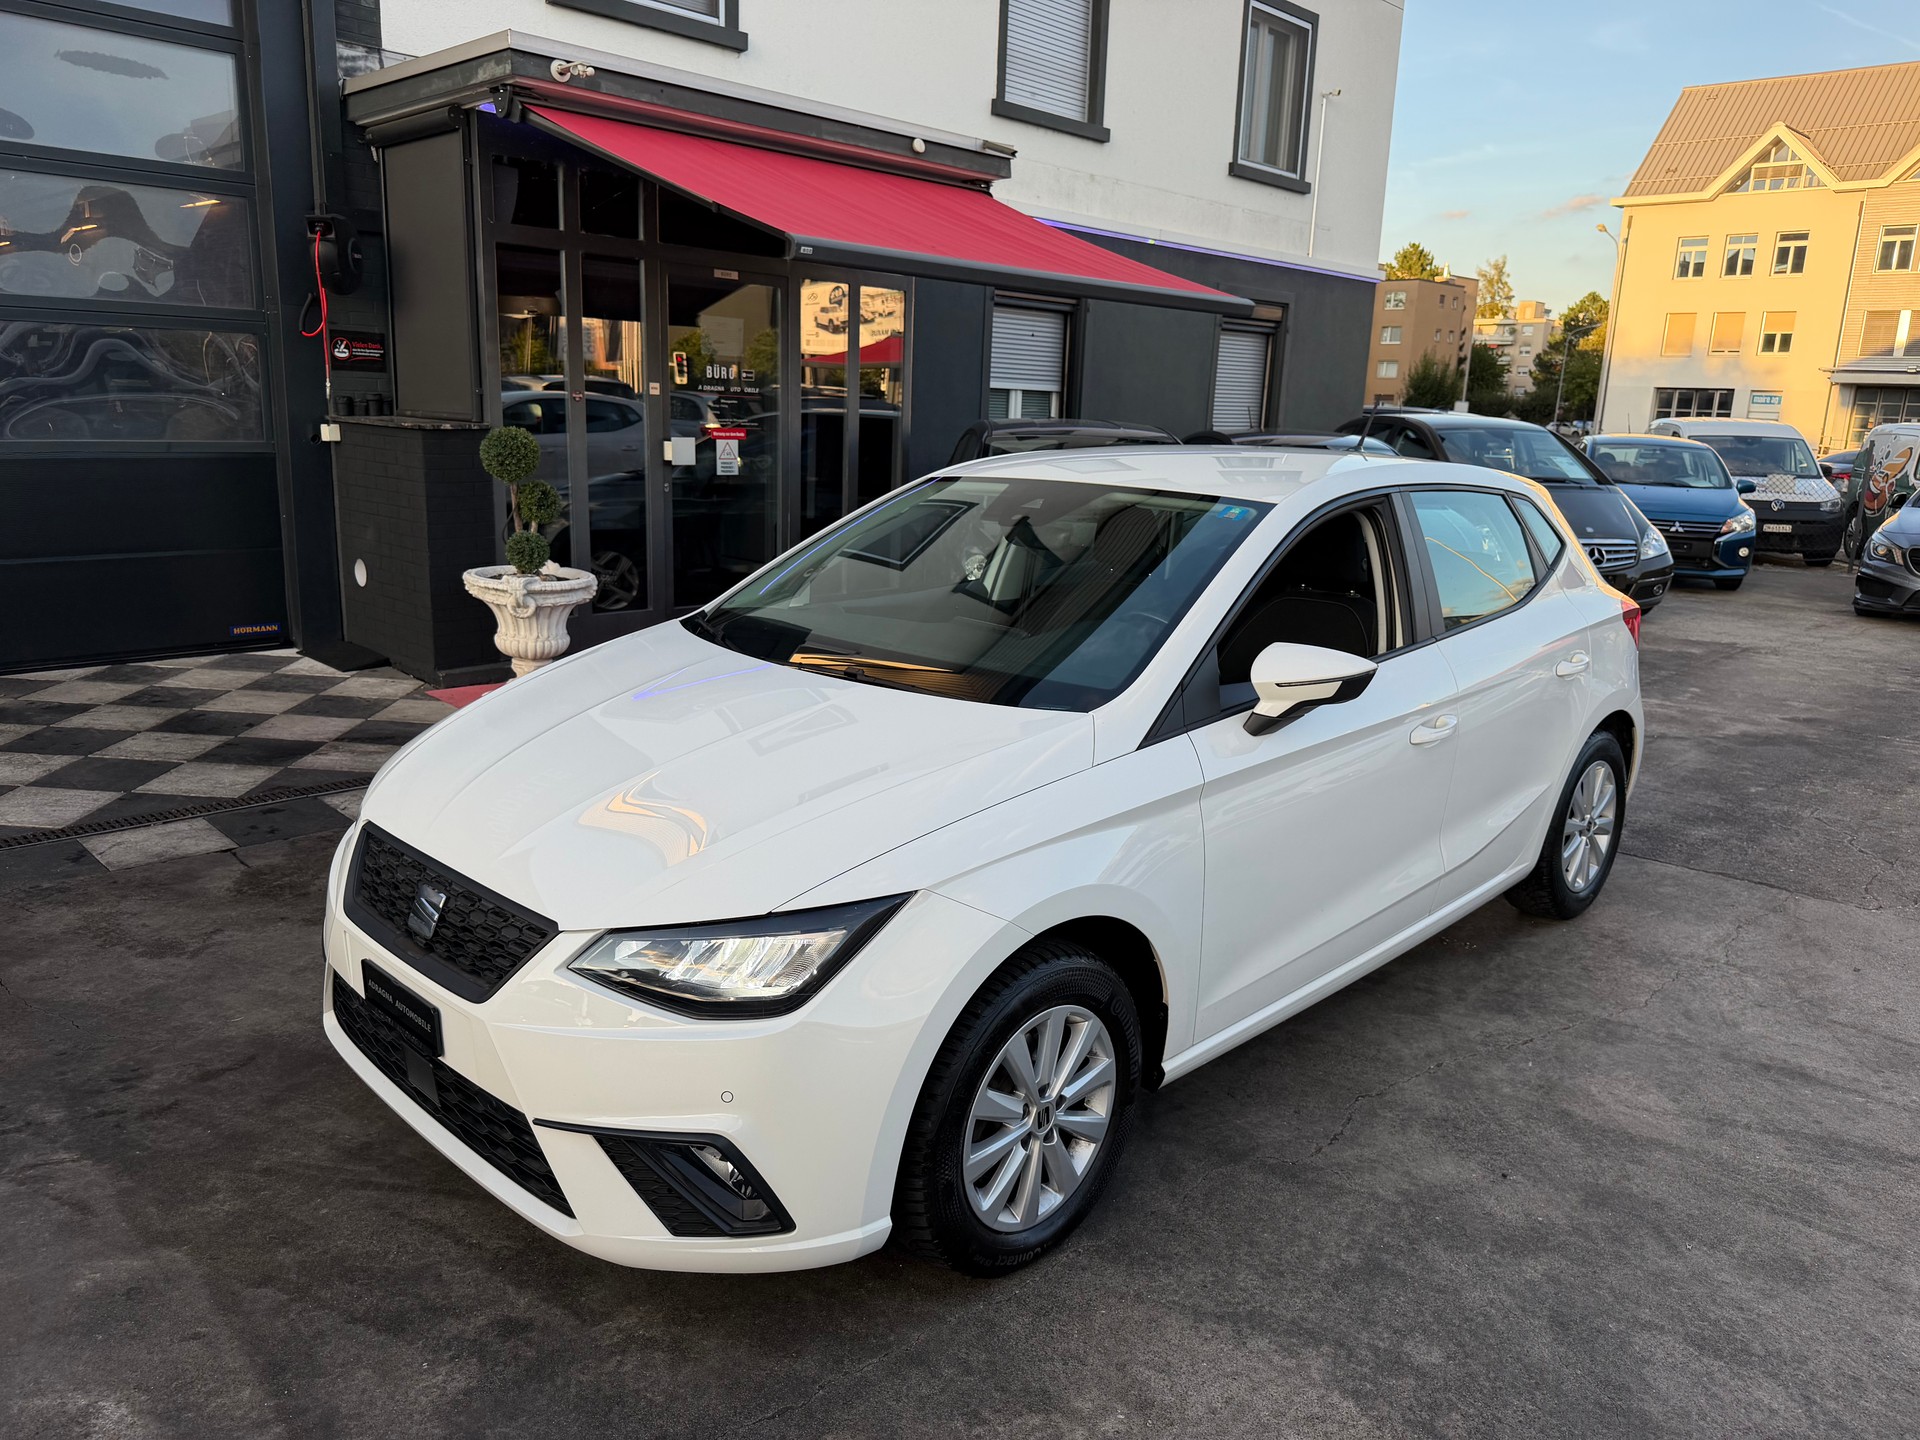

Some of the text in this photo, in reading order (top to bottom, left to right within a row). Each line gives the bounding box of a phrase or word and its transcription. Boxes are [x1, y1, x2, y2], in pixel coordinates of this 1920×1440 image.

[706, 364, 735, 380] BÜRO
[368, 979, 432, 1033] ADRAGNA AUTOMOBILE
